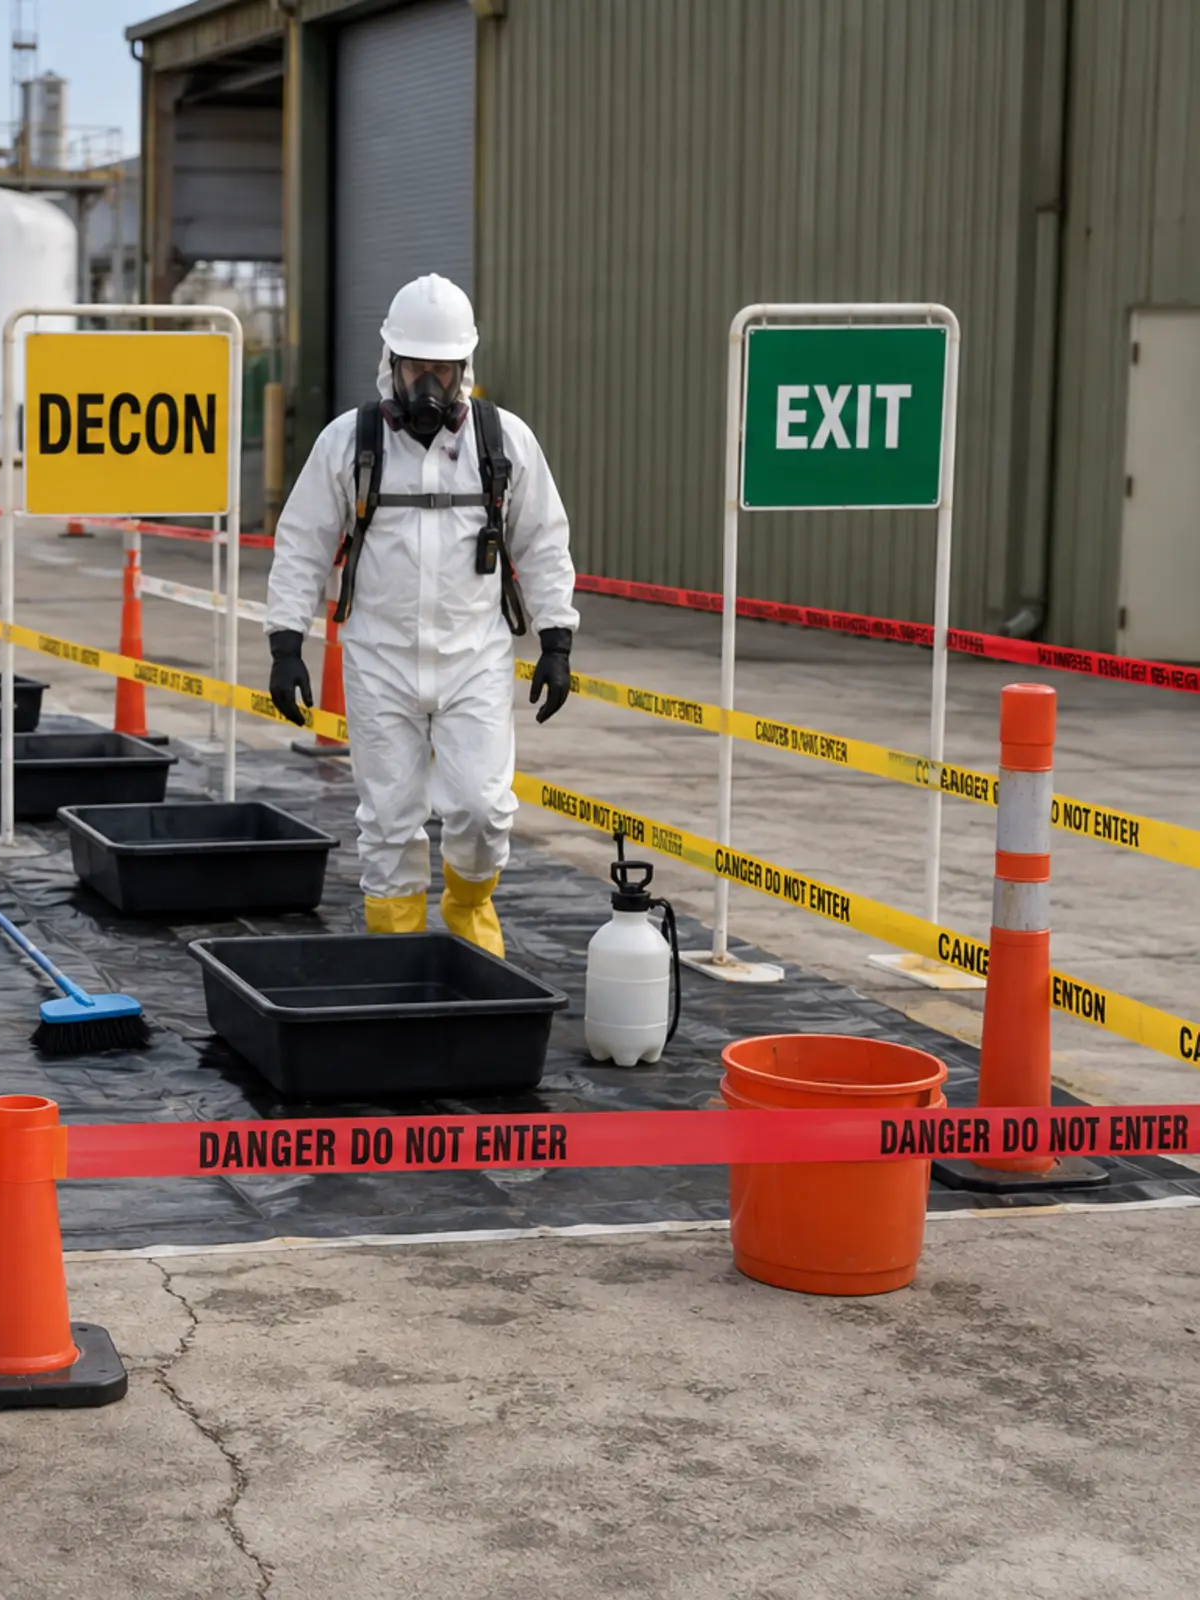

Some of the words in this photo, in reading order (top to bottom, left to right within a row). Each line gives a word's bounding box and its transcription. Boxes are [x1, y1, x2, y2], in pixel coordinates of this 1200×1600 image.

[38, 392, 216, 455] DECON
[776, 384, 912, 449] EXIT
[1063, 803, 1091, 833] NOT
[765, 867, 780, 895] DO
[784, 875, 806, 905] NOT
[200, 1129, 335, 1169] DANGER
[351, 1127, 392, 1165] DO
[405, 1126, 464, 1164] NOT
[475, 1124, 567, 1163] ENTER
[880, 1118, 990, 1154] DANGER
[1003, 1118, 1038, 1152] DO
[1049, 1116, 1100, 1151] NOT
[1109, 1114, 1189, 1150] ENTER
